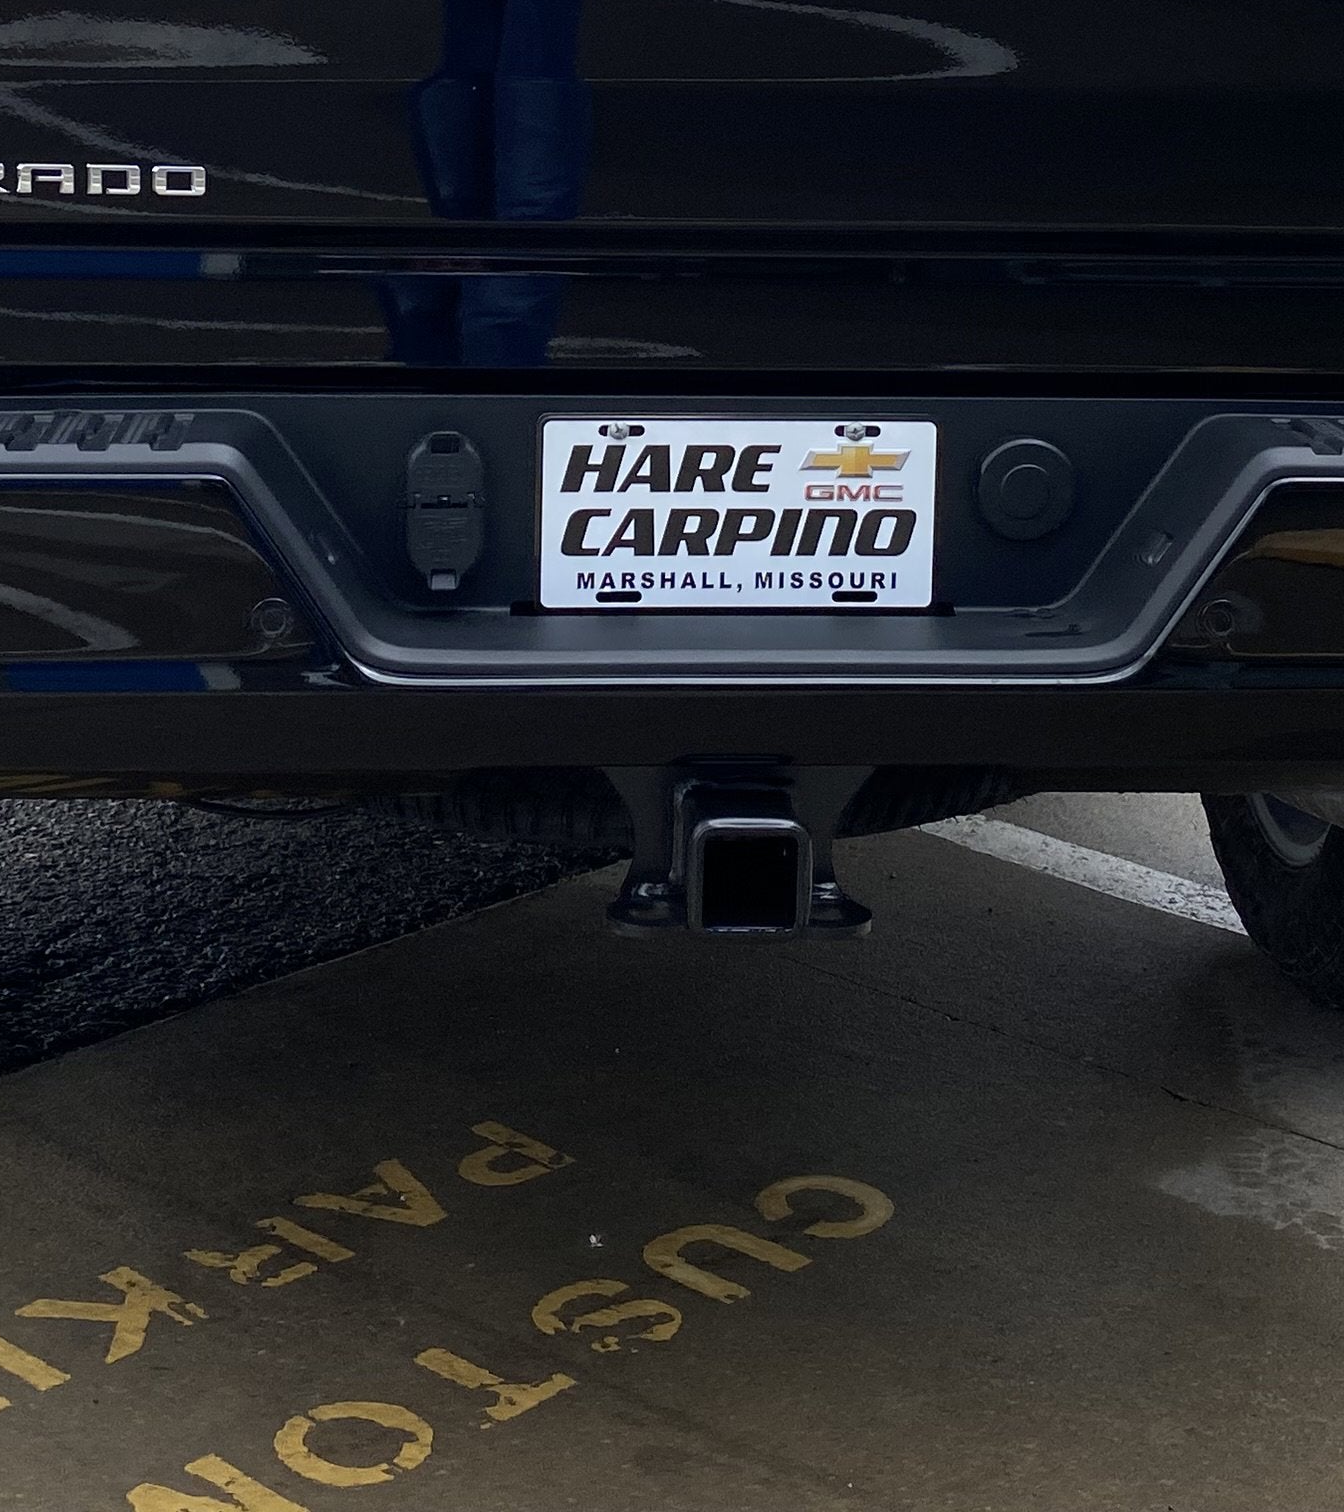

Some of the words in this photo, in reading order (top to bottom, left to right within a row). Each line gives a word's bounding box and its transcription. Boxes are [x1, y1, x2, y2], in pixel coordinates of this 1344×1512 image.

[560, 445, 781, 493] HARE
[804, 484, 904, 502] GMC
[560, 508, 917, 558] CARPINO
[576, 571, 743, 593] MARSHALL,
[754, 571, 898, 591] MISSOURI
